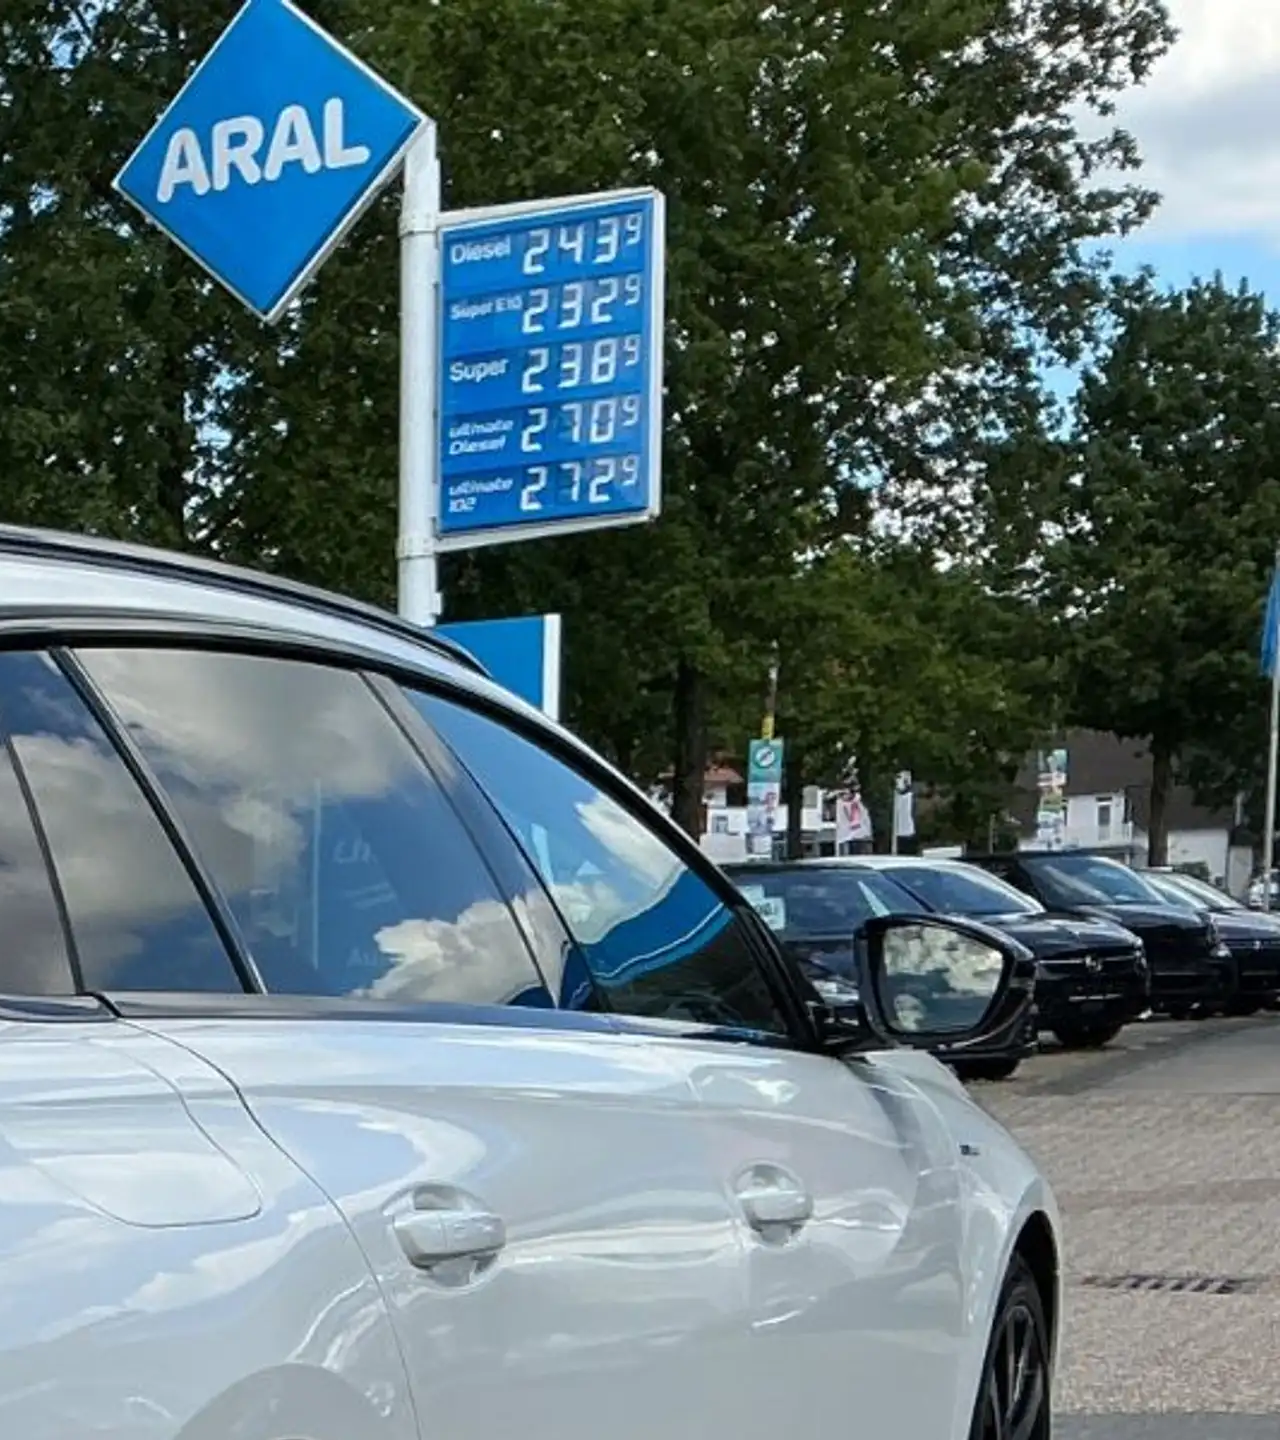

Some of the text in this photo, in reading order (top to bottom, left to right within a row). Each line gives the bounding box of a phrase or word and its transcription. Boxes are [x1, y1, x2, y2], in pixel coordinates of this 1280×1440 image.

[156, 98, 371, 203] ARAL
[450, 235, 511, 265] Diesel
[450, 301, 492, 319] Super
[495, 294, 522, 313] E10
[449, 358, 509, 383] Super
[449, 435, 506, 455] Diesel
